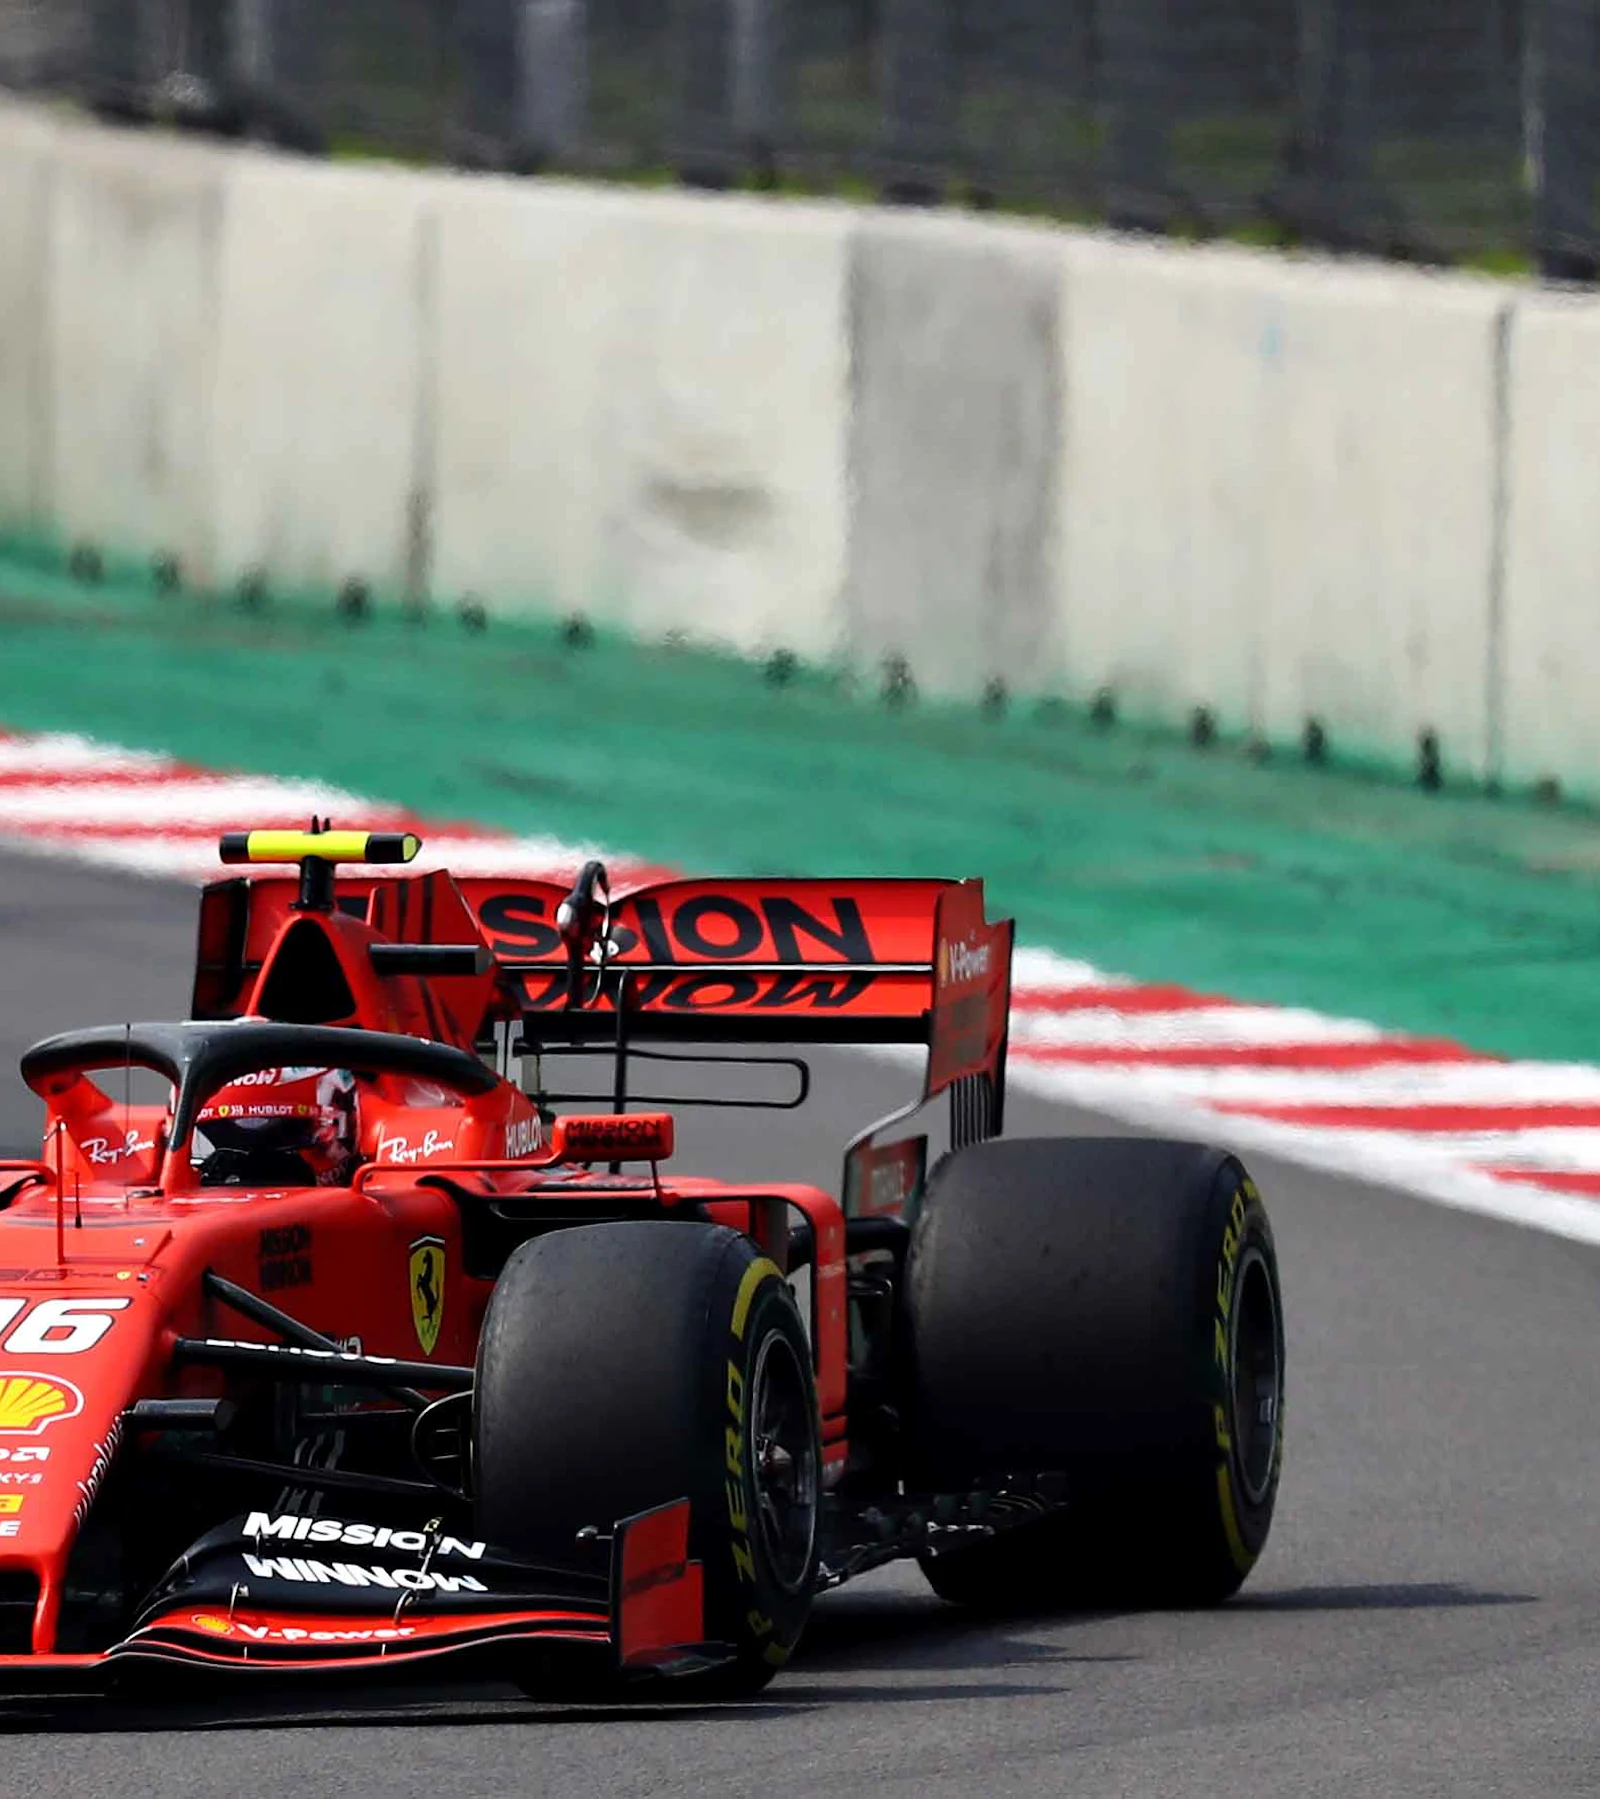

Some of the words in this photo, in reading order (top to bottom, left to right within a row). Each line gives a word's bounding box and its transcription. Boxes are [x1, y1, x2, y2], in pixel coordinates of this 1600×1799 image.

[248, 1105, 293, 1115] HUBLOT
[80, 1130, 155, 1164] Ray-Ban
[380, 1130, 453, 1162] Ray-Ban
[1214, 1190, 1246, 1374] ZERO
[725, 1358, 756, 1583] ZERO
[242, 1511, 487, 1559] MISSION
[242, 1552, 489, 1591] WINNOW
[236, 1622, 417, 1641] V-Power
